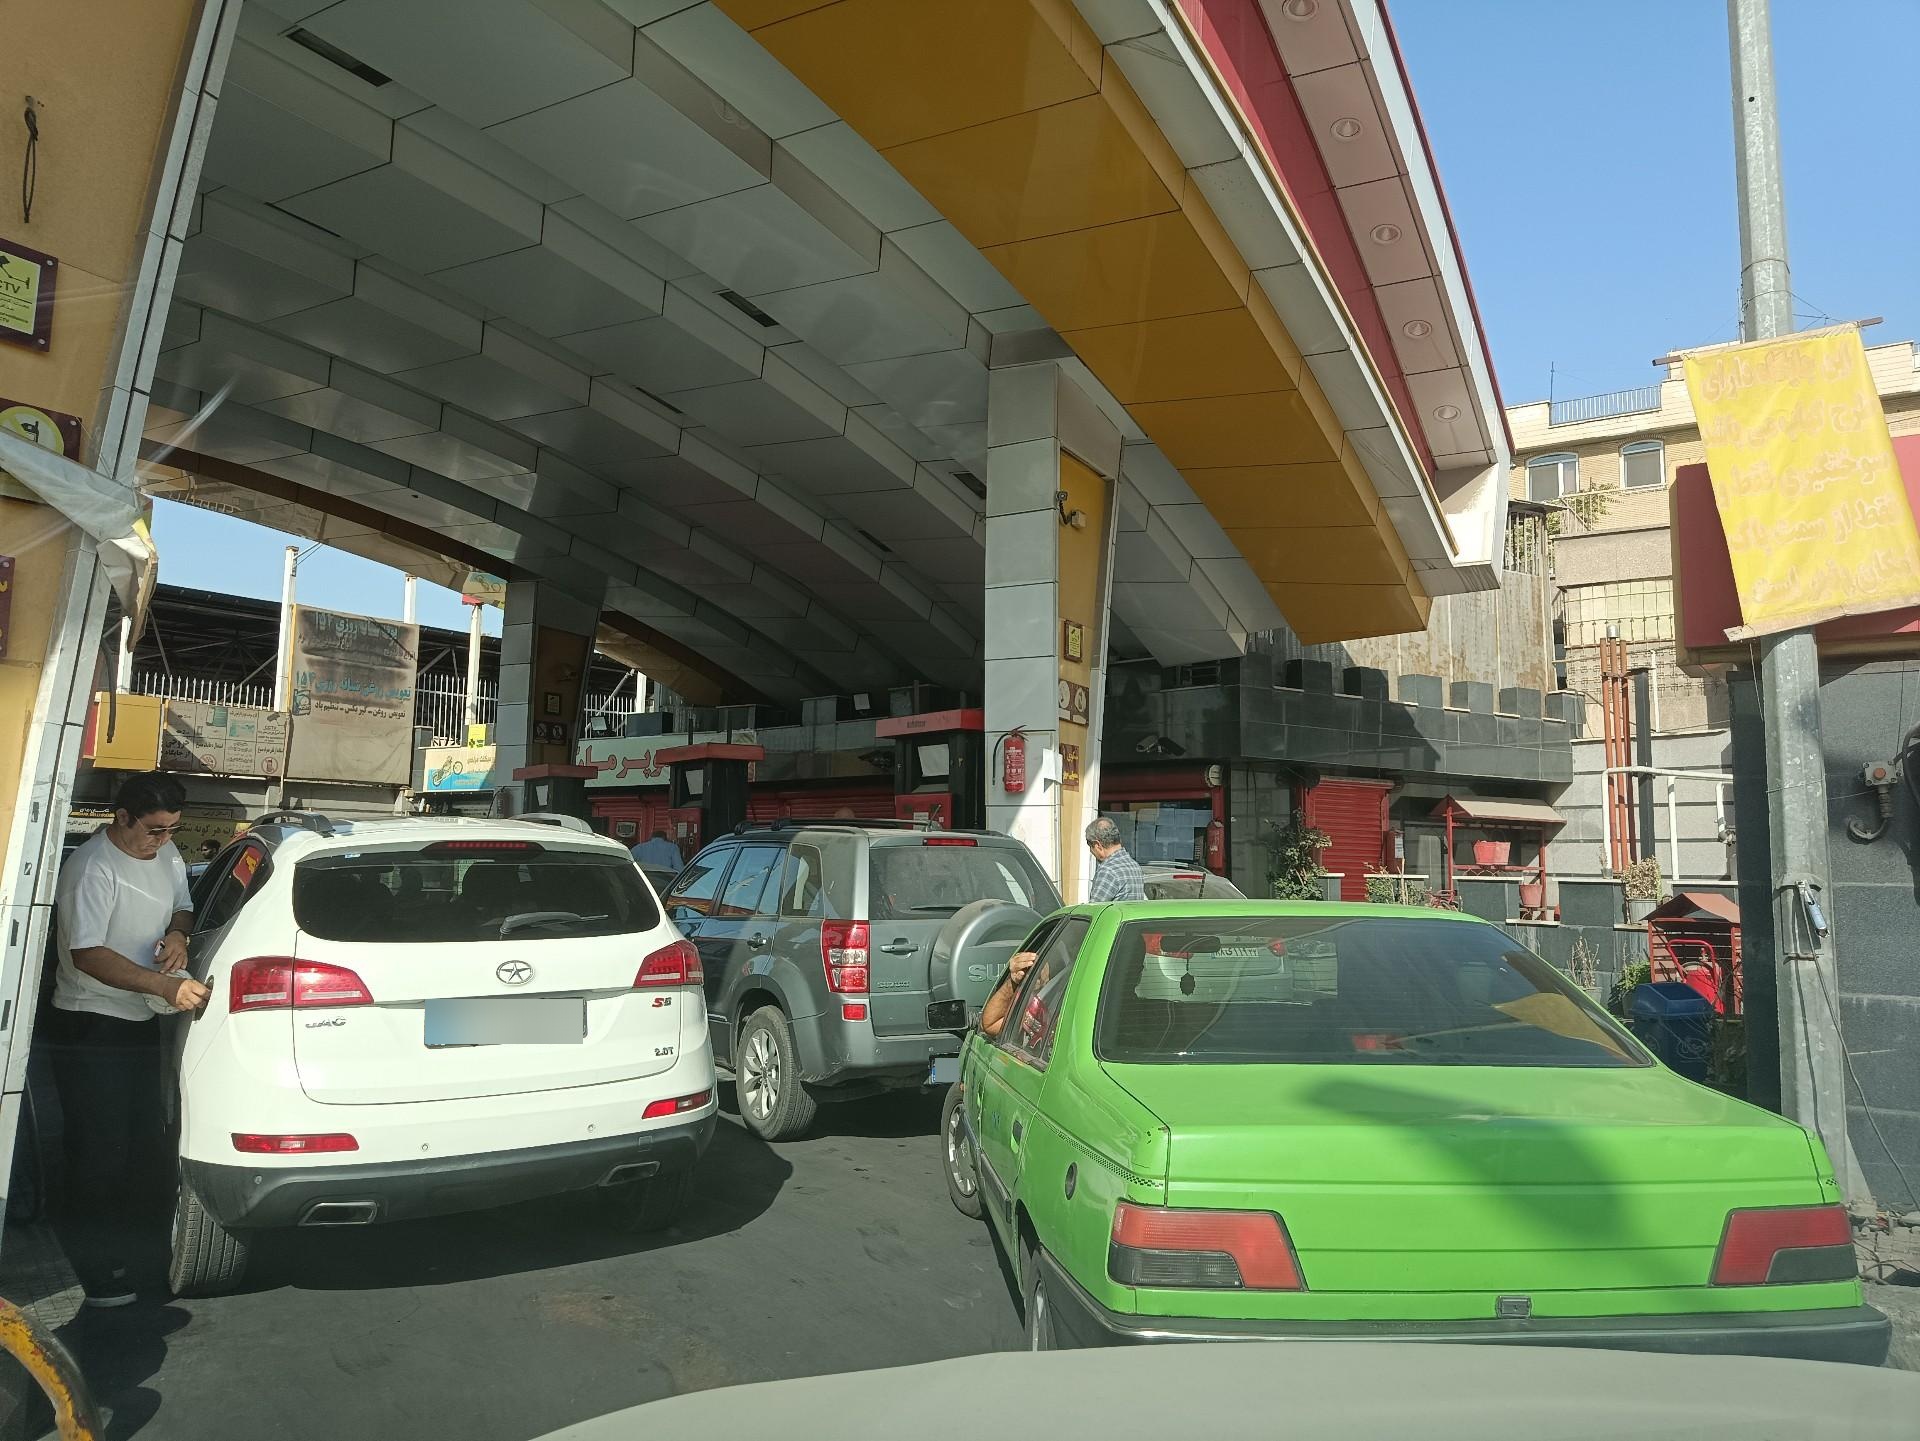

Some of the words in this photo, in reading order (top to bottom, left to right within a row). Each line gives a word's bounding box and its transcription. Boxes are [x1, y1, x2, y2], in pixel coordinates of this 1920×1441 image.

[1700, 356, 1754, 403] دارای
[616, 748, 669, 779] وپر
[654, 1046, 674, 1057] 2.0T
